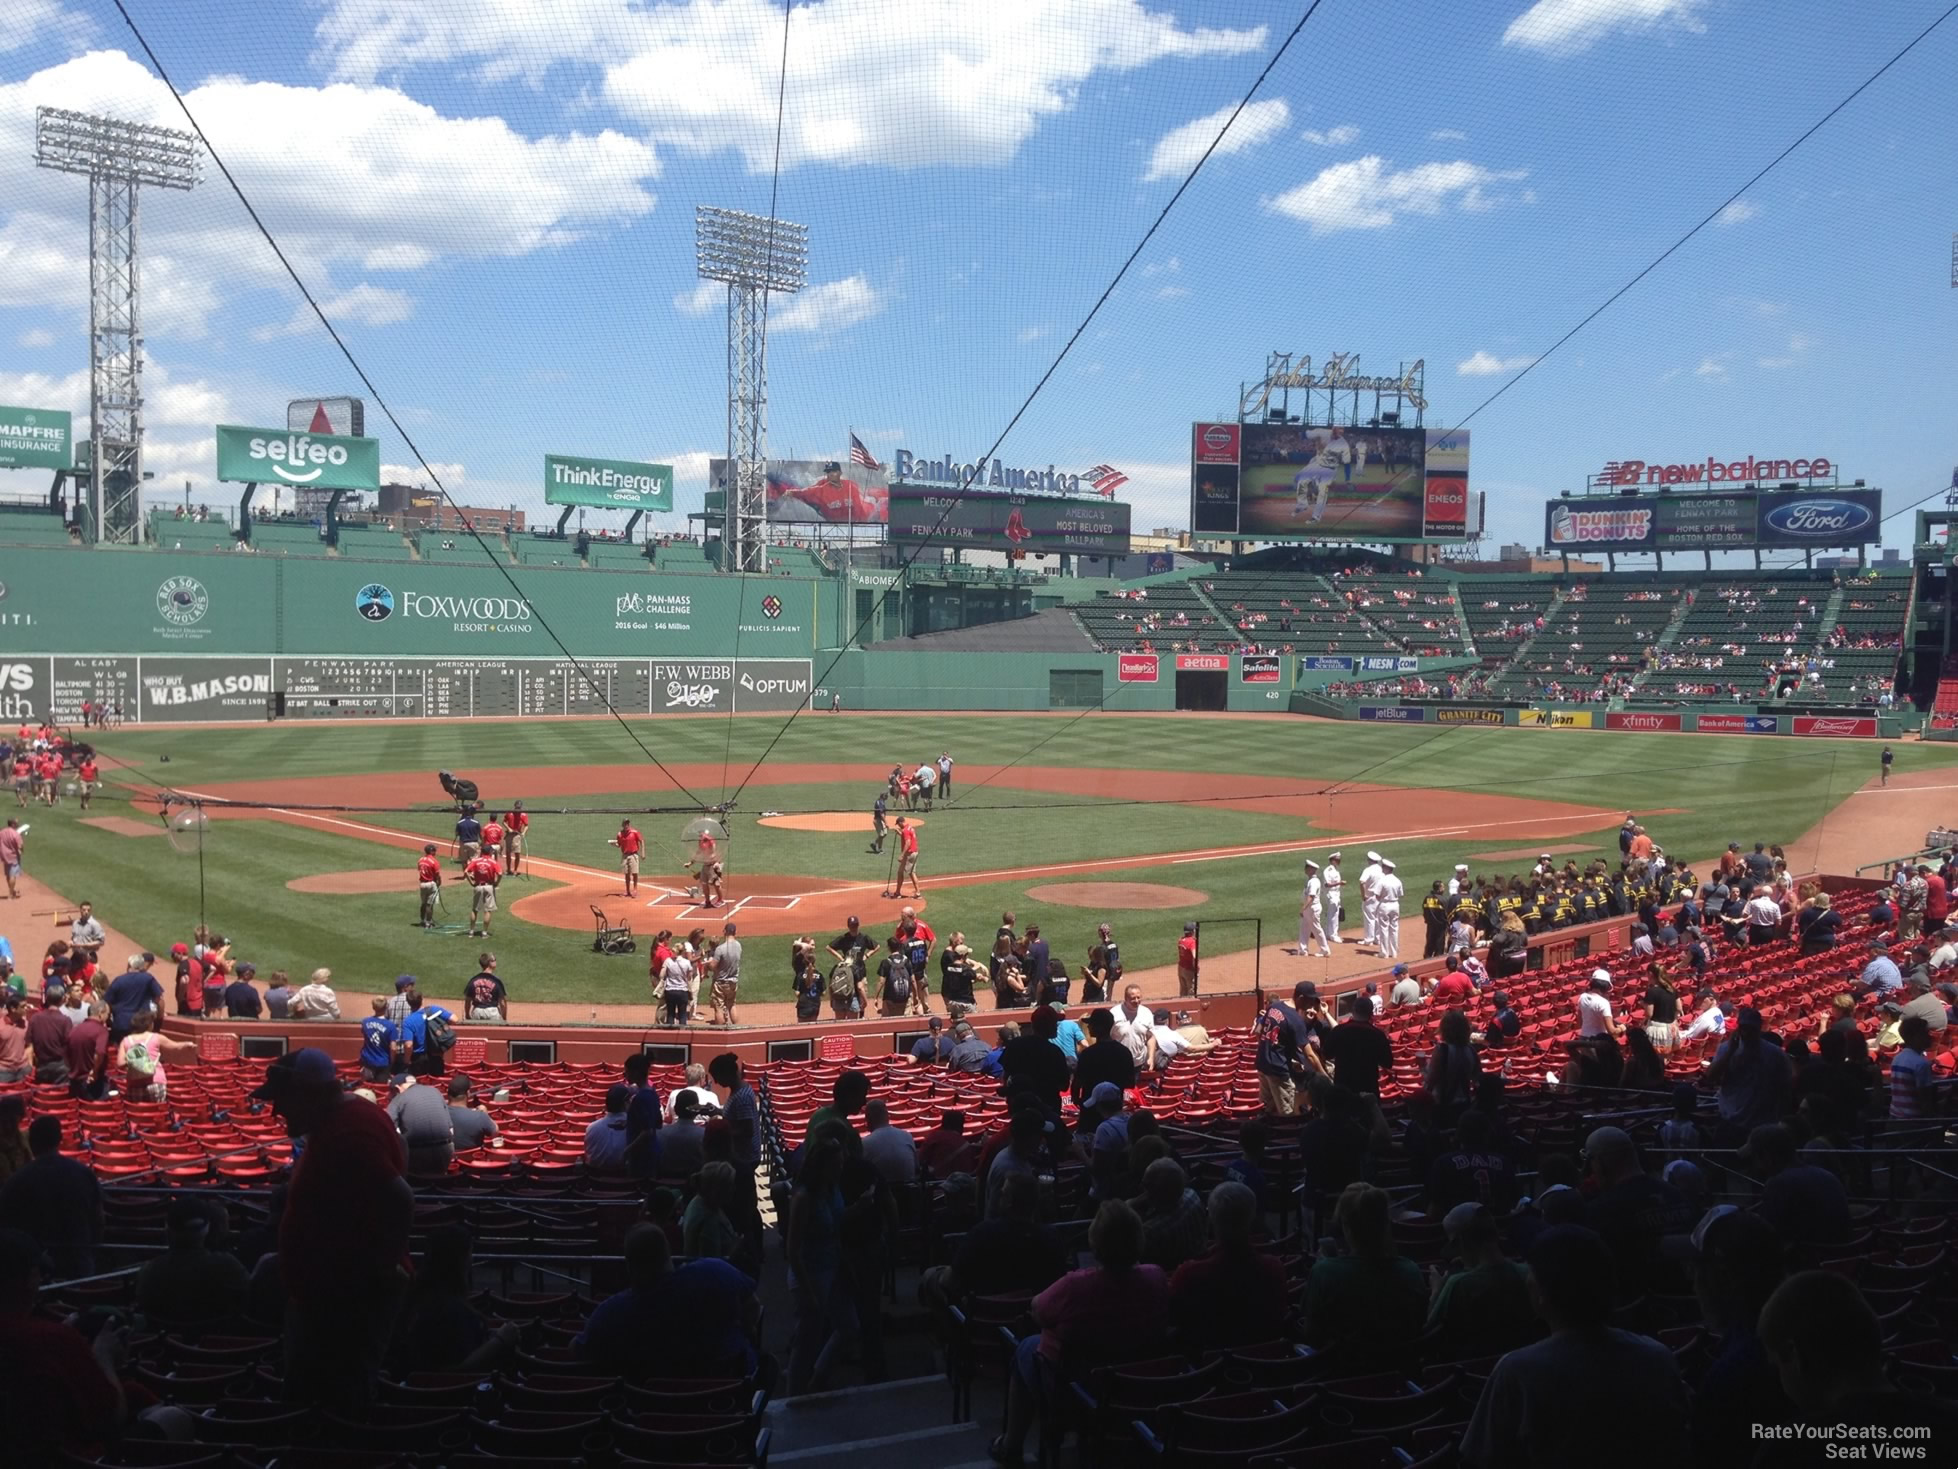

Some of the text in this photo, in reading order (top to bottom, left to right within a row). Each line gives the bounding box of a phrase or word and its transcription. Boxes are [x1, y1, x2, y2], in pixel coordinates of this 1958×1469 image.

[1239, 350, 1428, 416] John Hancock
[0, 424, 65, 440] MAPFRE
[0, 440, 61, 452] INSURANCE
[896, 449, 1079, 493] Bank of America
[1428, 495, 1463, 504] ENEOS
[1680, 500, 1720, 508] WELCOME
[1065, 508, 1105, 519] AMERICA'S
[1579, 511, 1649, 526] DUNKIN'
[1675, 509, 1711, 517] FENWAY
[1786, 505, 1850, 529] Ford
[950, 527, 974, 538] PARK
[1056, 521, 1112, 533] MOST BELOVED
[1579, 524, 1645, 539] DONUTS
[1677, 525, 1700, 533] HOME
[1720, 524, 1736, 532] THE
[1064, 535, 1104, 546] BALLPARK
[1669, 534, 1703, 542] BOSTON
[1727, 533, 1743, 541] SOX
[160, 578, 200, 599] RED SOX
[647, 595, 691, 604] PAN-MASS
[162, 596, 206, 623] SCHOLARS
[646, 605, 691, 614] CHALLENGE
[454, 624, 532, 632] RESORT CASINO
[615, 621, 631, 629] 2016
[655, 622, 667, 630] $46
[1184, 657, 1220, 668] aetna
[1243, 664, 1279, 672] Safelite
[1368, 658, 1394, 669] NESN
[686, 666, 731, 680] WEBB
[143, 674, 183, 686] WHO BUT
[756, 680, 806, 693] OPTUM
[55, 689, 83, 697] BOSTON
[1375, 708, 1407, 718] jetBlue
[1439, 711, 1503, 722] GRANITE CITY
[1536, 714, 1574, 725] Nikon
[1622, 715, 1664, 728] xfinity
[1699, 719, 1754, 728] Bank of America
[1815, 722, 1853, 731] Budweiser
[1451, 1154, 1503, 1170] DAD
